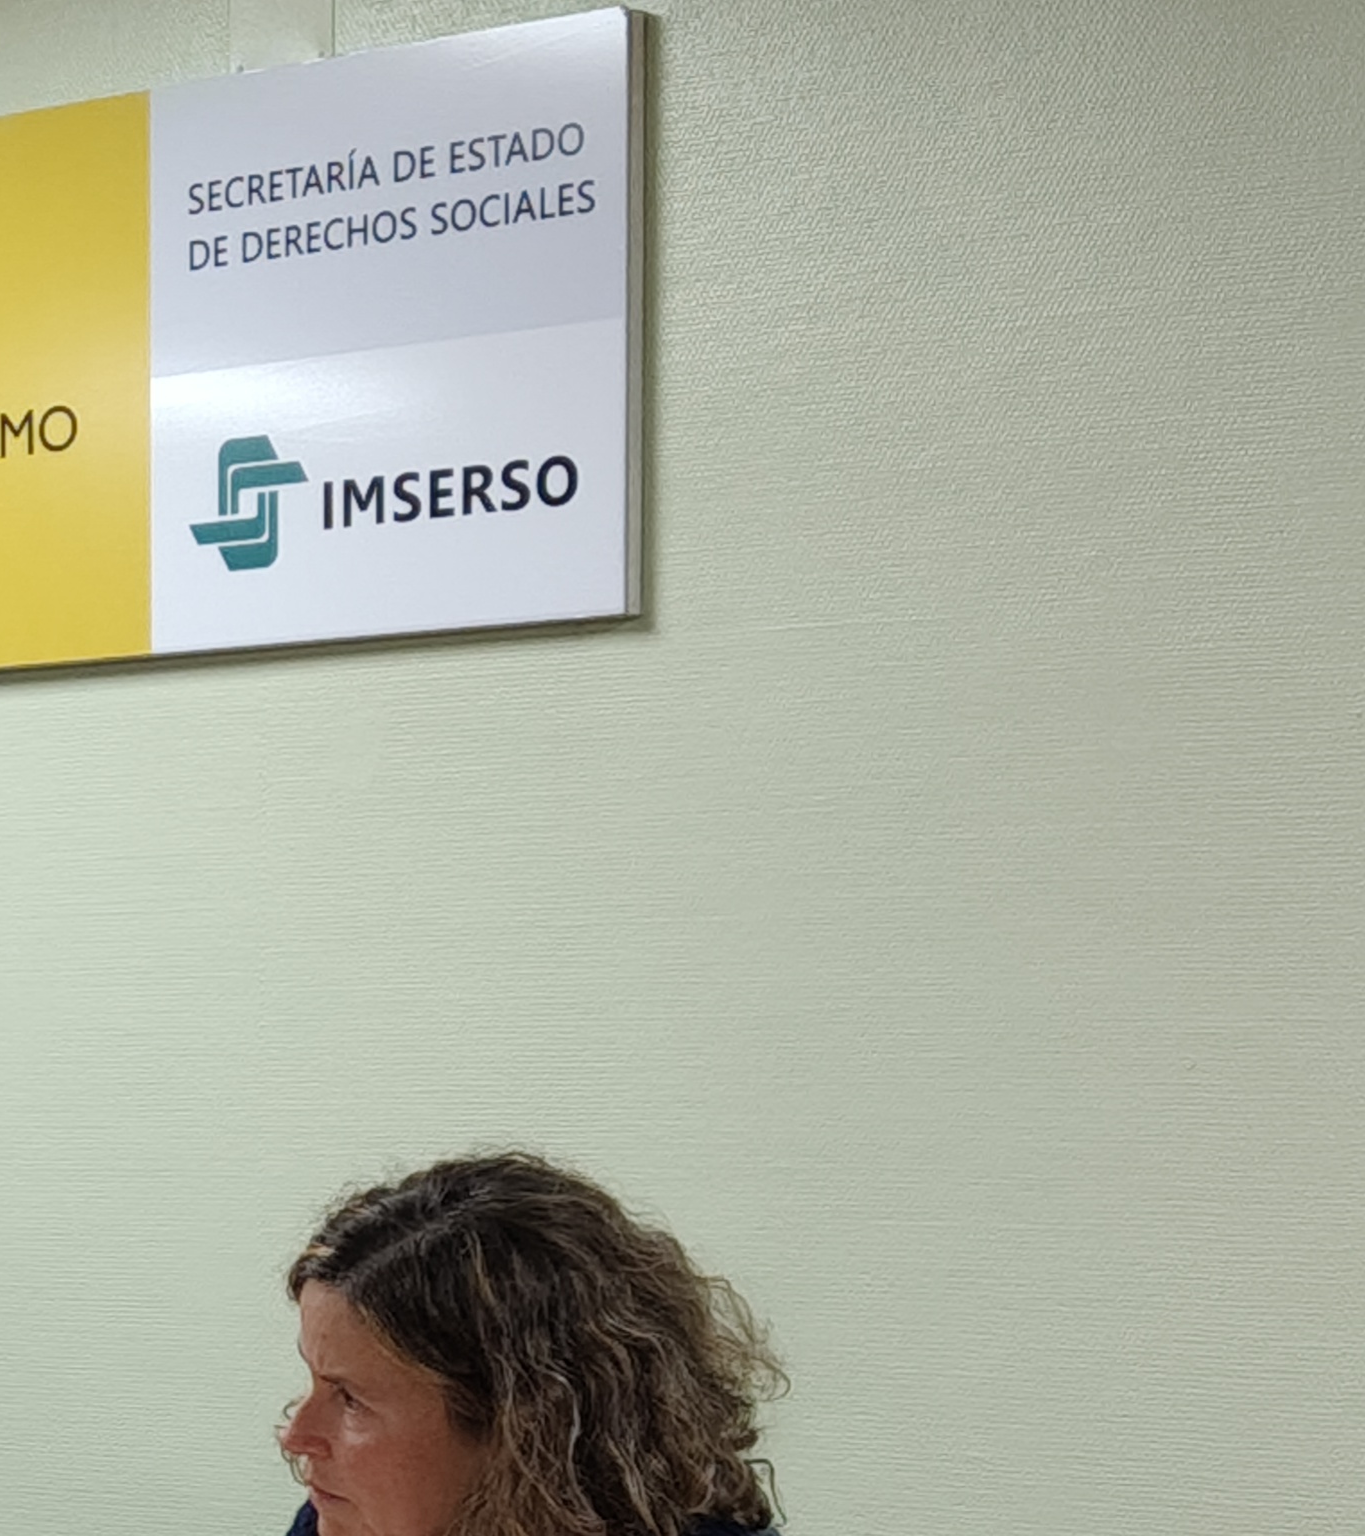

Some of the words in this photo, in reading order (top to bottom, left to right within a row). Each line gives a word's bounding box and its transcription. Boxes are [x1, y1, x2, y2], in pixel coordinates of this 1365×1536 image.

[188, 148, 381, 216] SECRETARÍA
[393, 145, 436, 184] DE
[449, 122, 585, 175] ESTADO
[188, 235, 229, 272] DE
[241, 206, 418, 264] DERECHOS
[430, 179, 596, 236] SOCIALES
[322, 455, 579, 531] IMSERSO
